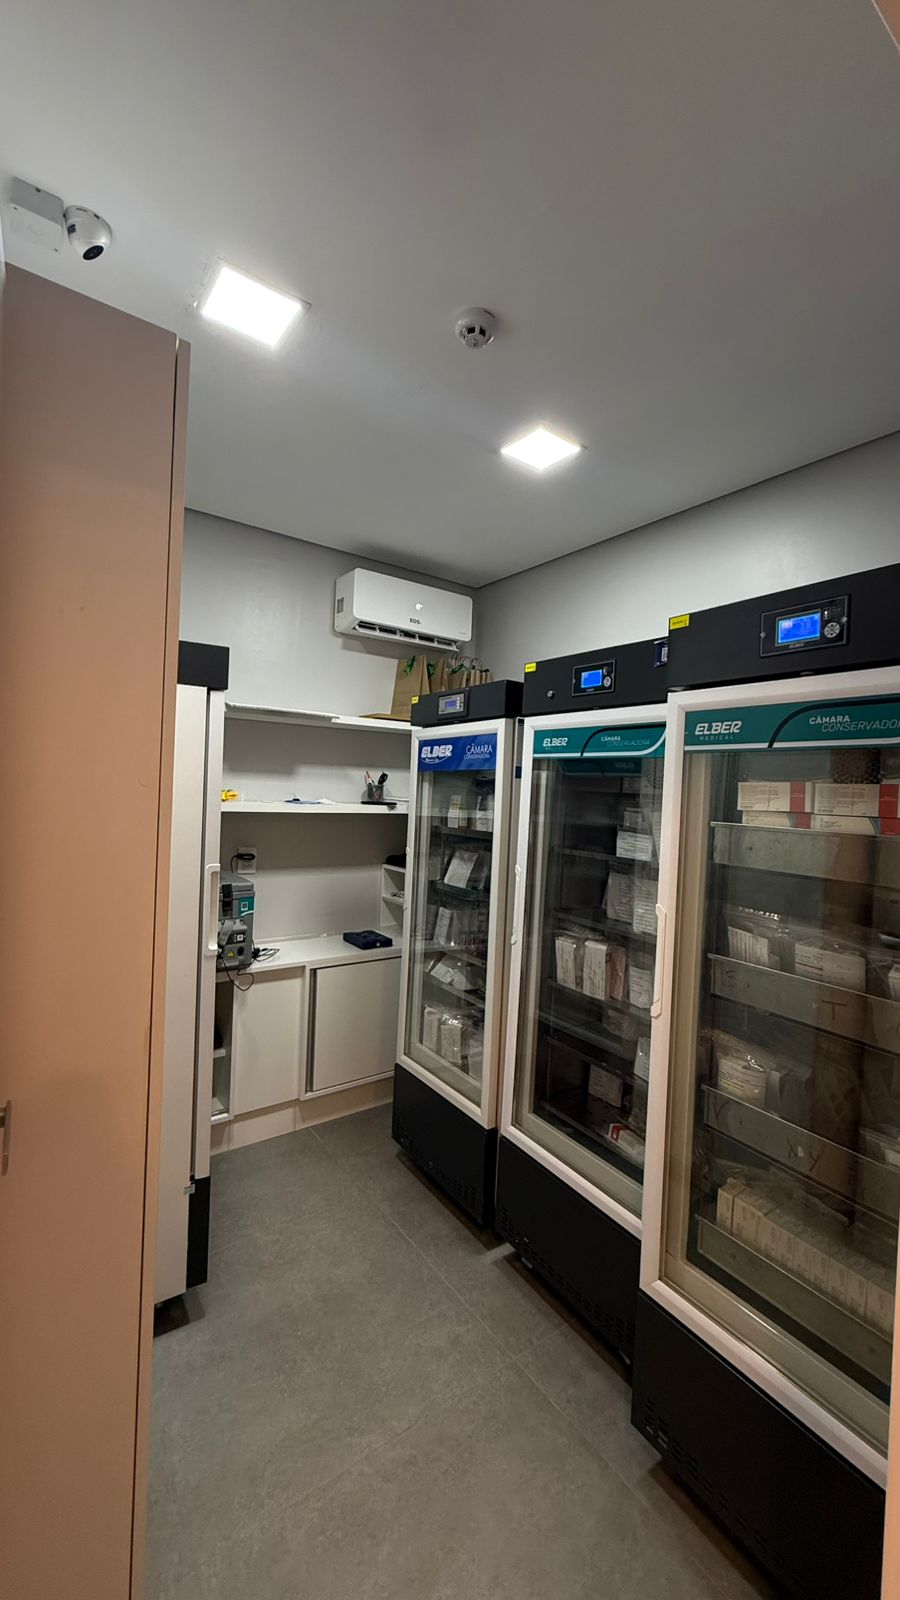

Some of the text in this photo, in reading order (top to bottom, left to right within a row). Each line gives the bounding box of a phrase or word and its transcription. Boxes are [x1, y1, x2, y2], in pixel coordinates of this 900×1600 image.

[808, 714, 850, 725] CÂMARA
[695, 720, 742, 735] ELBER
[542, 737, 569, 747] ELBER
[420, 744, 453, 758] ELBER
[465, 743, 493, 755] CÂMARA
